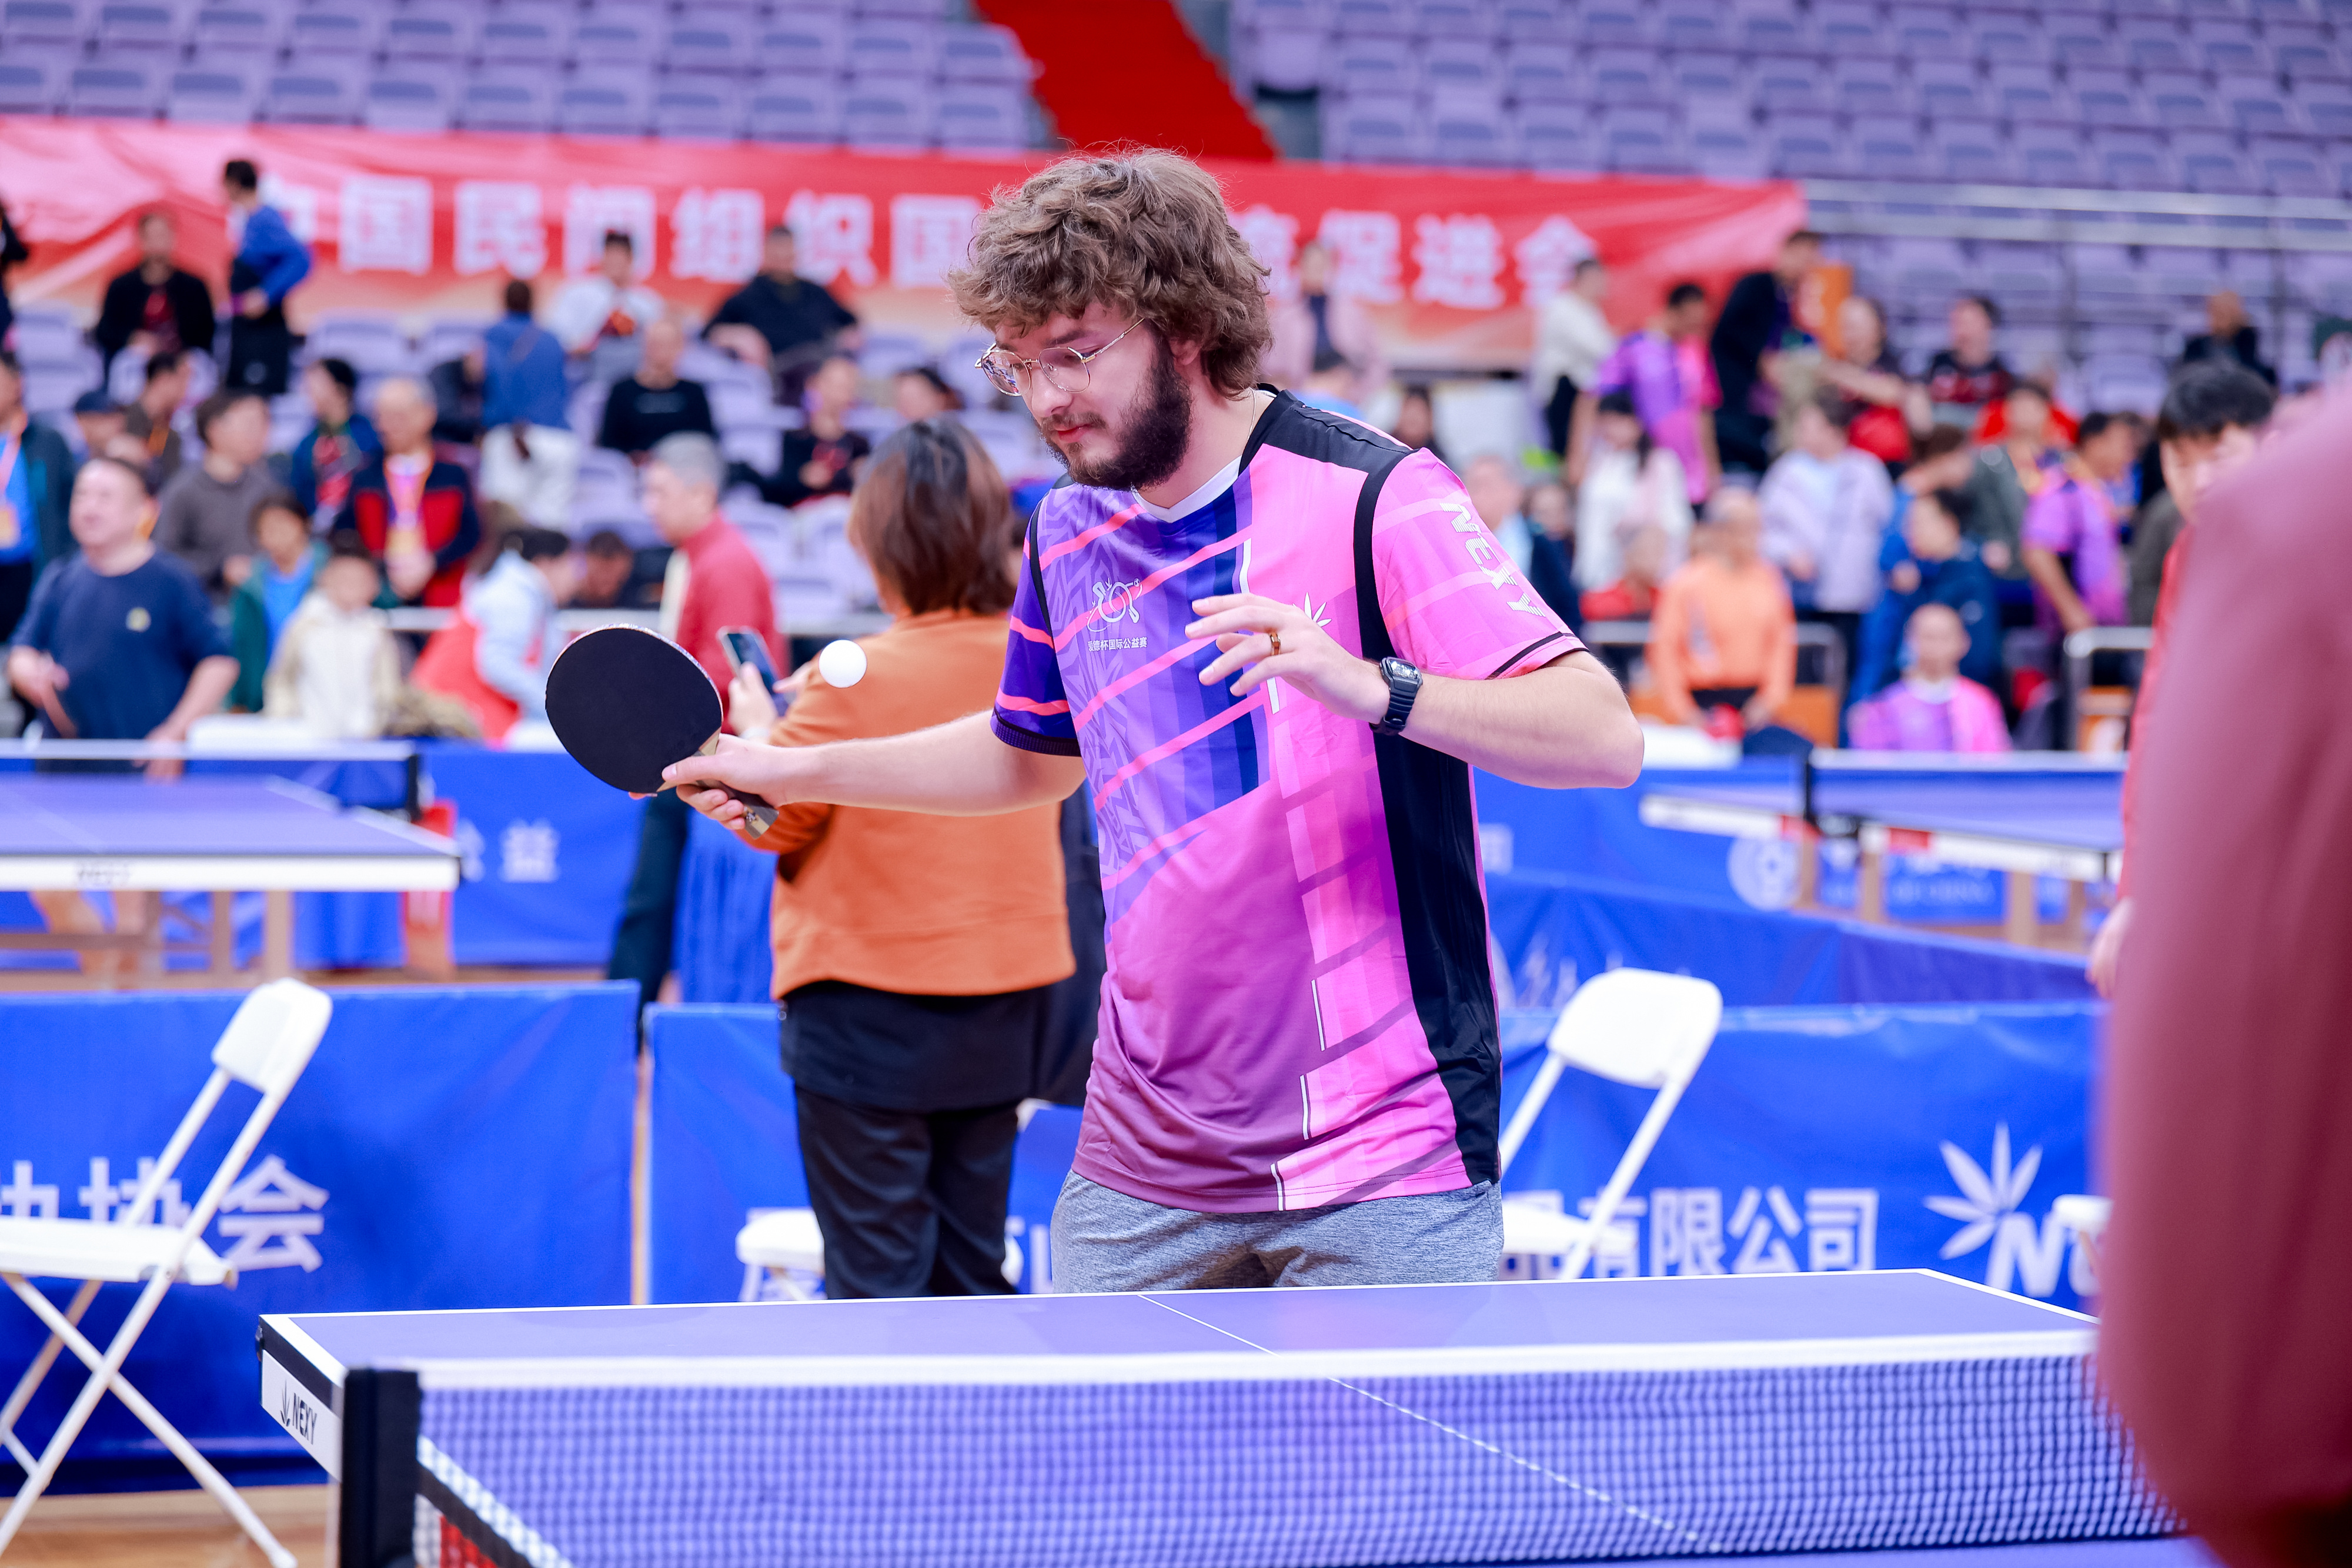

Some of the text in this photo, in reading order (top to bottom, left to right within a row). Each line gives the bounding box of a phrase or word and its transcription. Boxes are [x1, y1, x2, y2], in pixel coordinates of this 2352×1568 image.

[1439, 503, 1546, 618] NEXY
[1087, 636, 1148, 652] 爱德杯国际公益赛
[0, 1154, 329, 1273] 协会
[293, 1392, 318, 1445] NEXY
